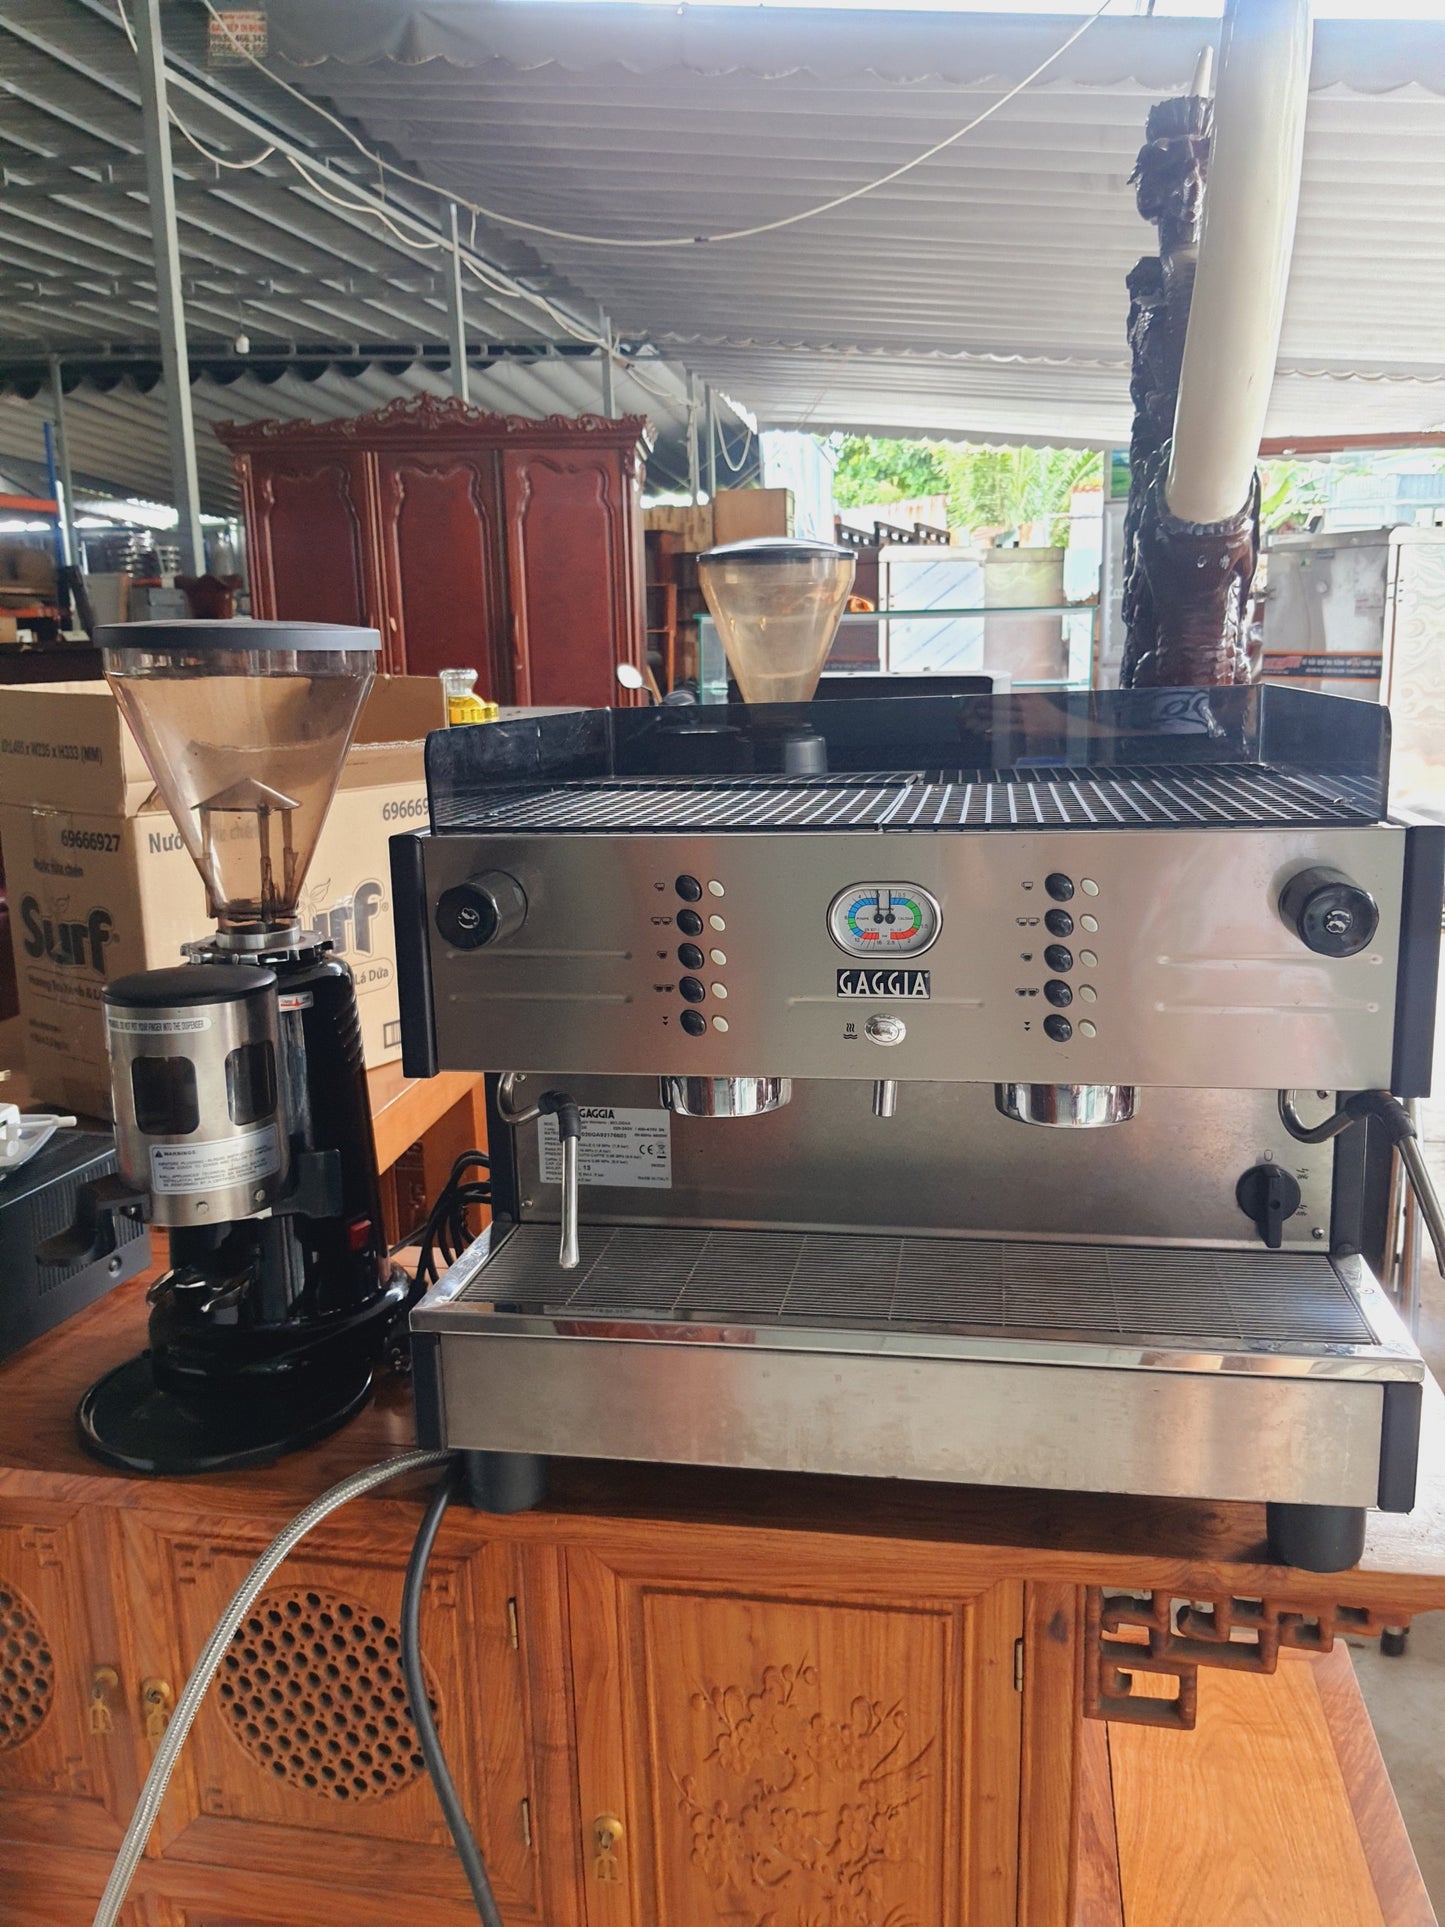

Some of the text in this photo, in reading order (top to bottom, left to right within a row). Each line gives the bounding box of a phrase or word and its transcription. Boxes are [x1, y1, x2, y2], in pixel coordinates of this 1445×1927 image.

[61, 829, 120, 852] 69666927
[22, 895, 113, 976] Surf
[355, 971, 367, 985] Lá
[839, 970, 929, 998] GAGGIA
[579, 1108, 615, 1119] GAGGIA
